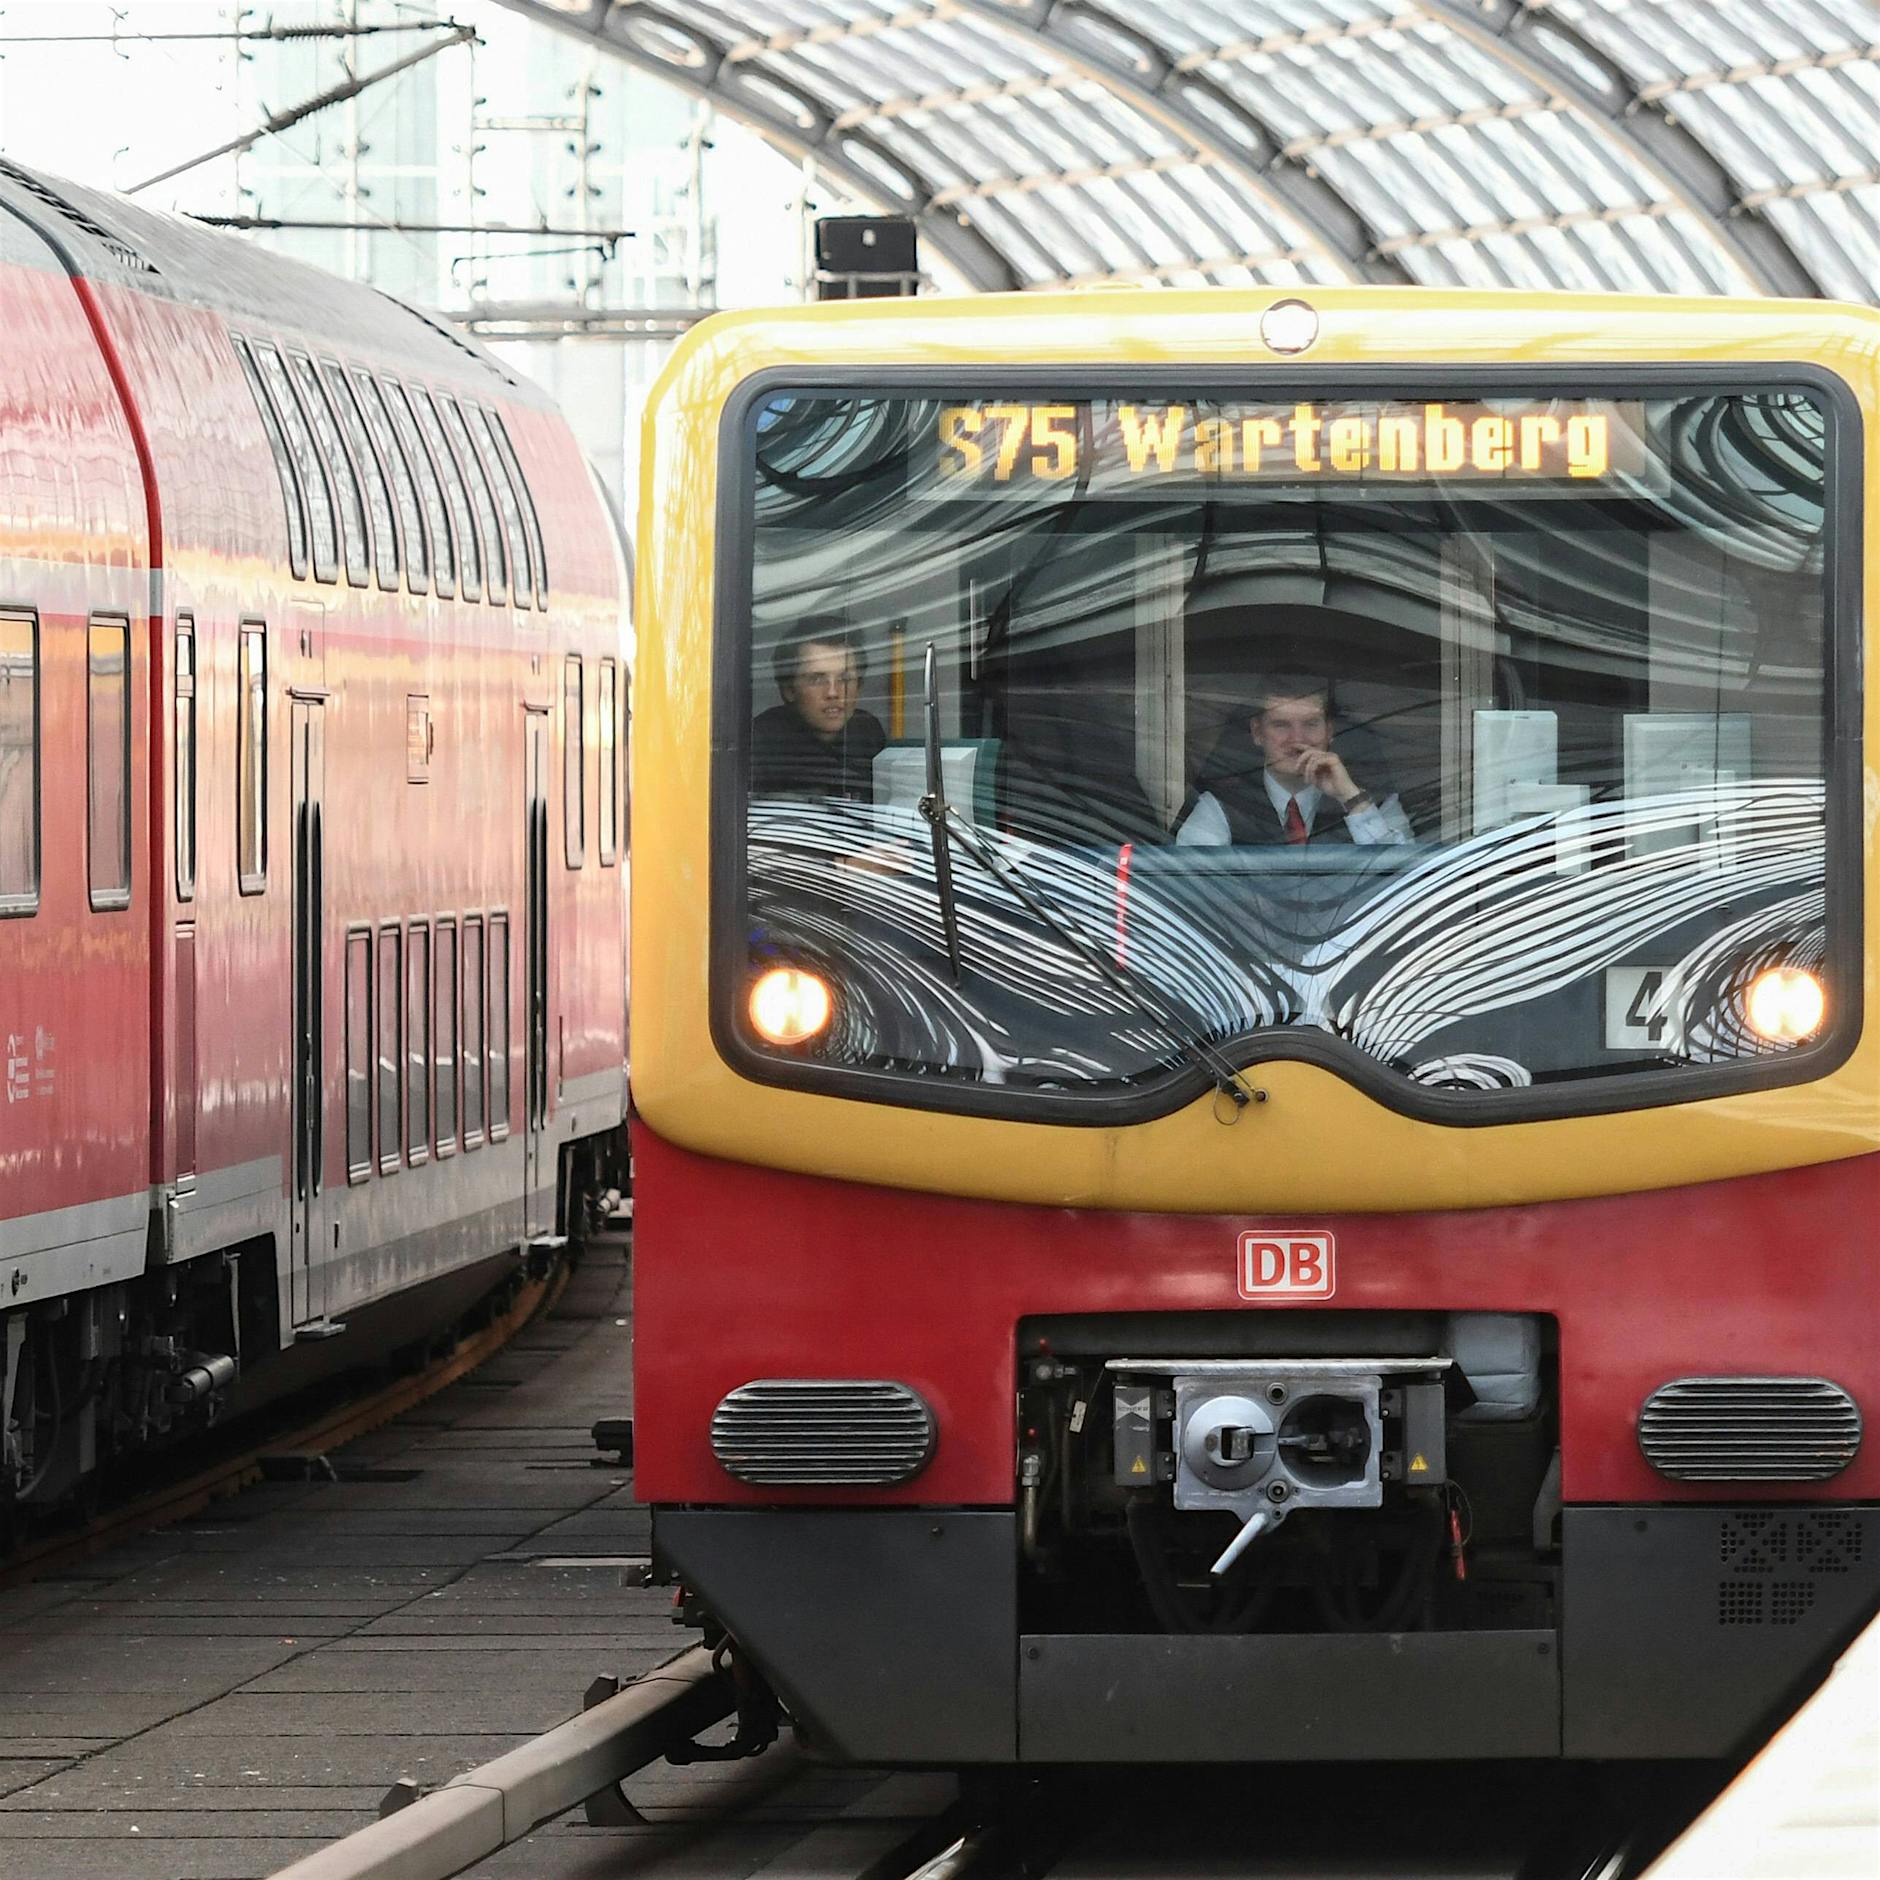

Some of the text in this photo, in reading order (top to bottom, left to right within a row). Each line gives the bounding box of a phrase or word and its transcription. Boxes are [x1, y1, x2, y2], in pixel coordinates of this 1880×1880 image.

[938, 403, 1608, 481] S75 Wartenberg
[1625, 971, 1668, 1041] 4
[1251, 1242, 1322, 1287] DB
